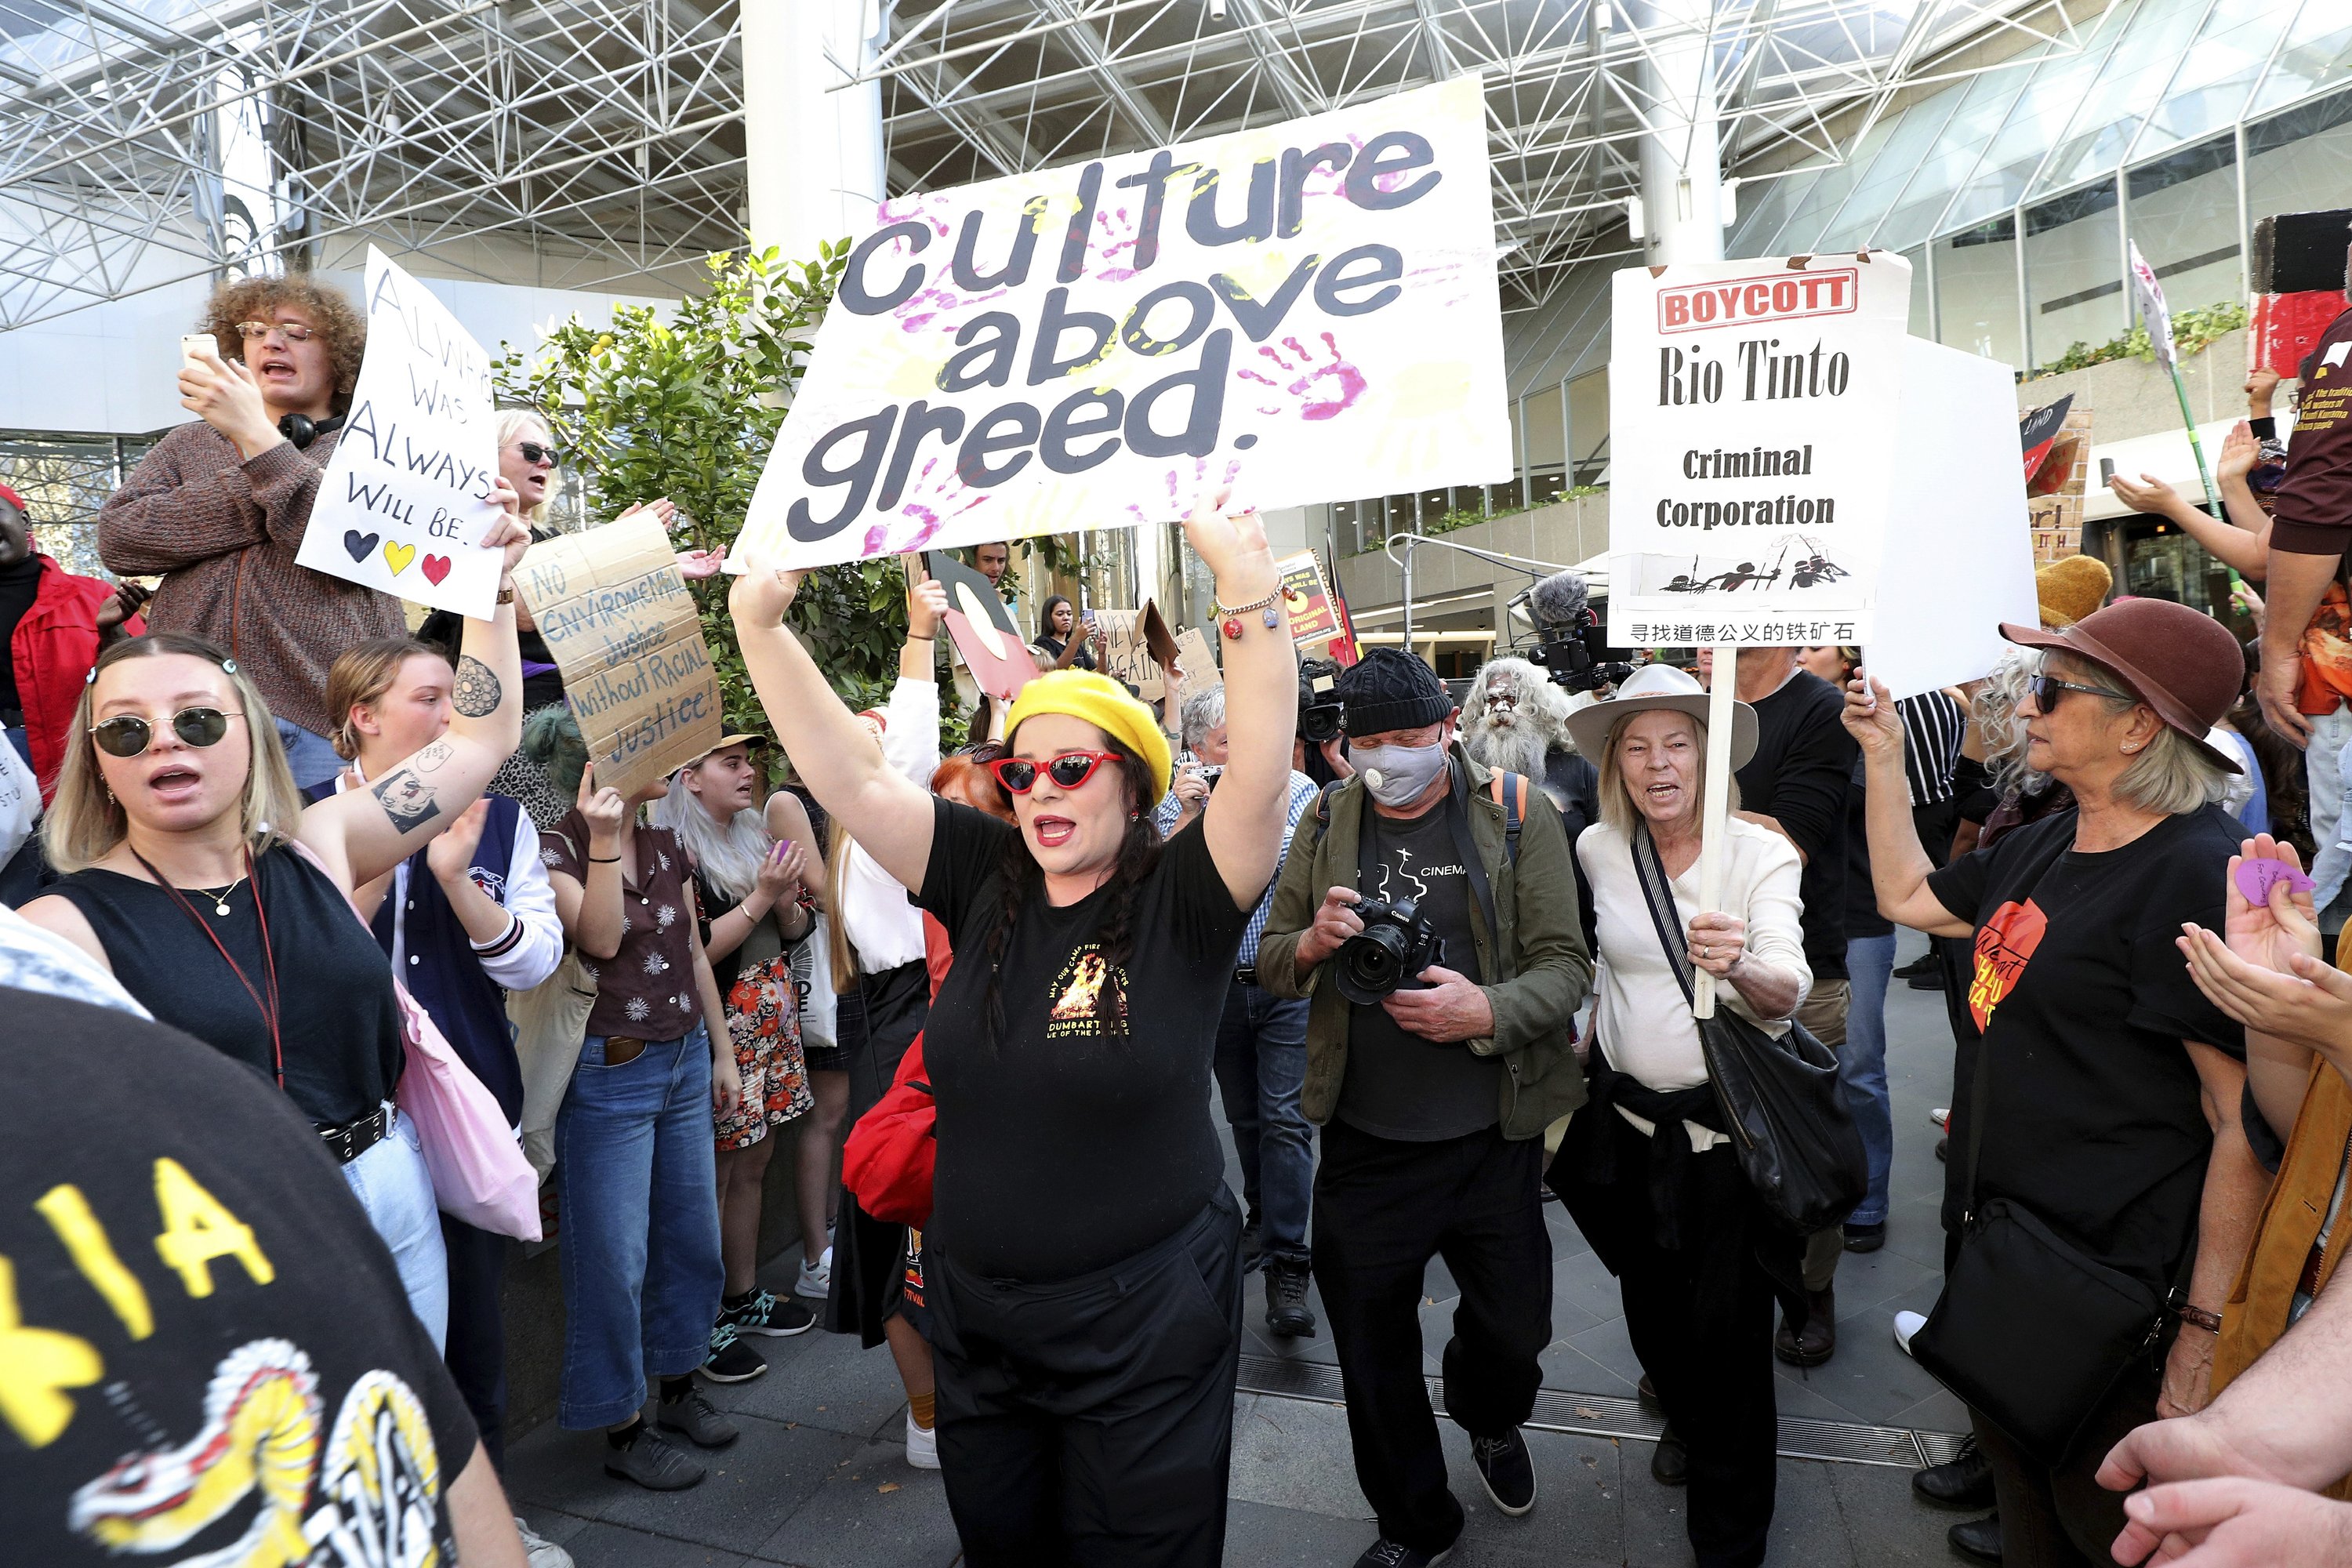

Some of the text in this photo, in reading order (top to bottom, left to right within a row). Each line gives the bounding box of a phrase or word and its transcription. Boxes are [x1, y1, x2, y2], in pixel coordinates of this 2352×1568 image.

[838, 130, 1442, 317] culture
[935, 244, 1403, 392] above
[1664, 275, 1850, 327] BOYCOTT
[408, 363, 467, 423] WAS
[1657, 337, 1850, 407] Rio Tinto
[339, 400, 491, 499] ALWAYS
[785, 328, 1258, 543] greed.
[1683, 445, 1813, 479] Criminal
[348, 471, 468, 545] WILL BE.
[1657, 495, 1835, 530] Corporation
[531, 563, 566, 602] NO
[1288, 605, 1328, 625] ORIGINAL
[1294, 619, 1319, 633] LAND
[1630, 622, 1855, 642] 寻找道德公义的铁矿石
[1391, 910, 1410, 923] Canon
[1049, 981, 1059, 998] MAY
[1058, 967, 1070, 980] OUR
[1069, 946, 1082, 967] CAMP
